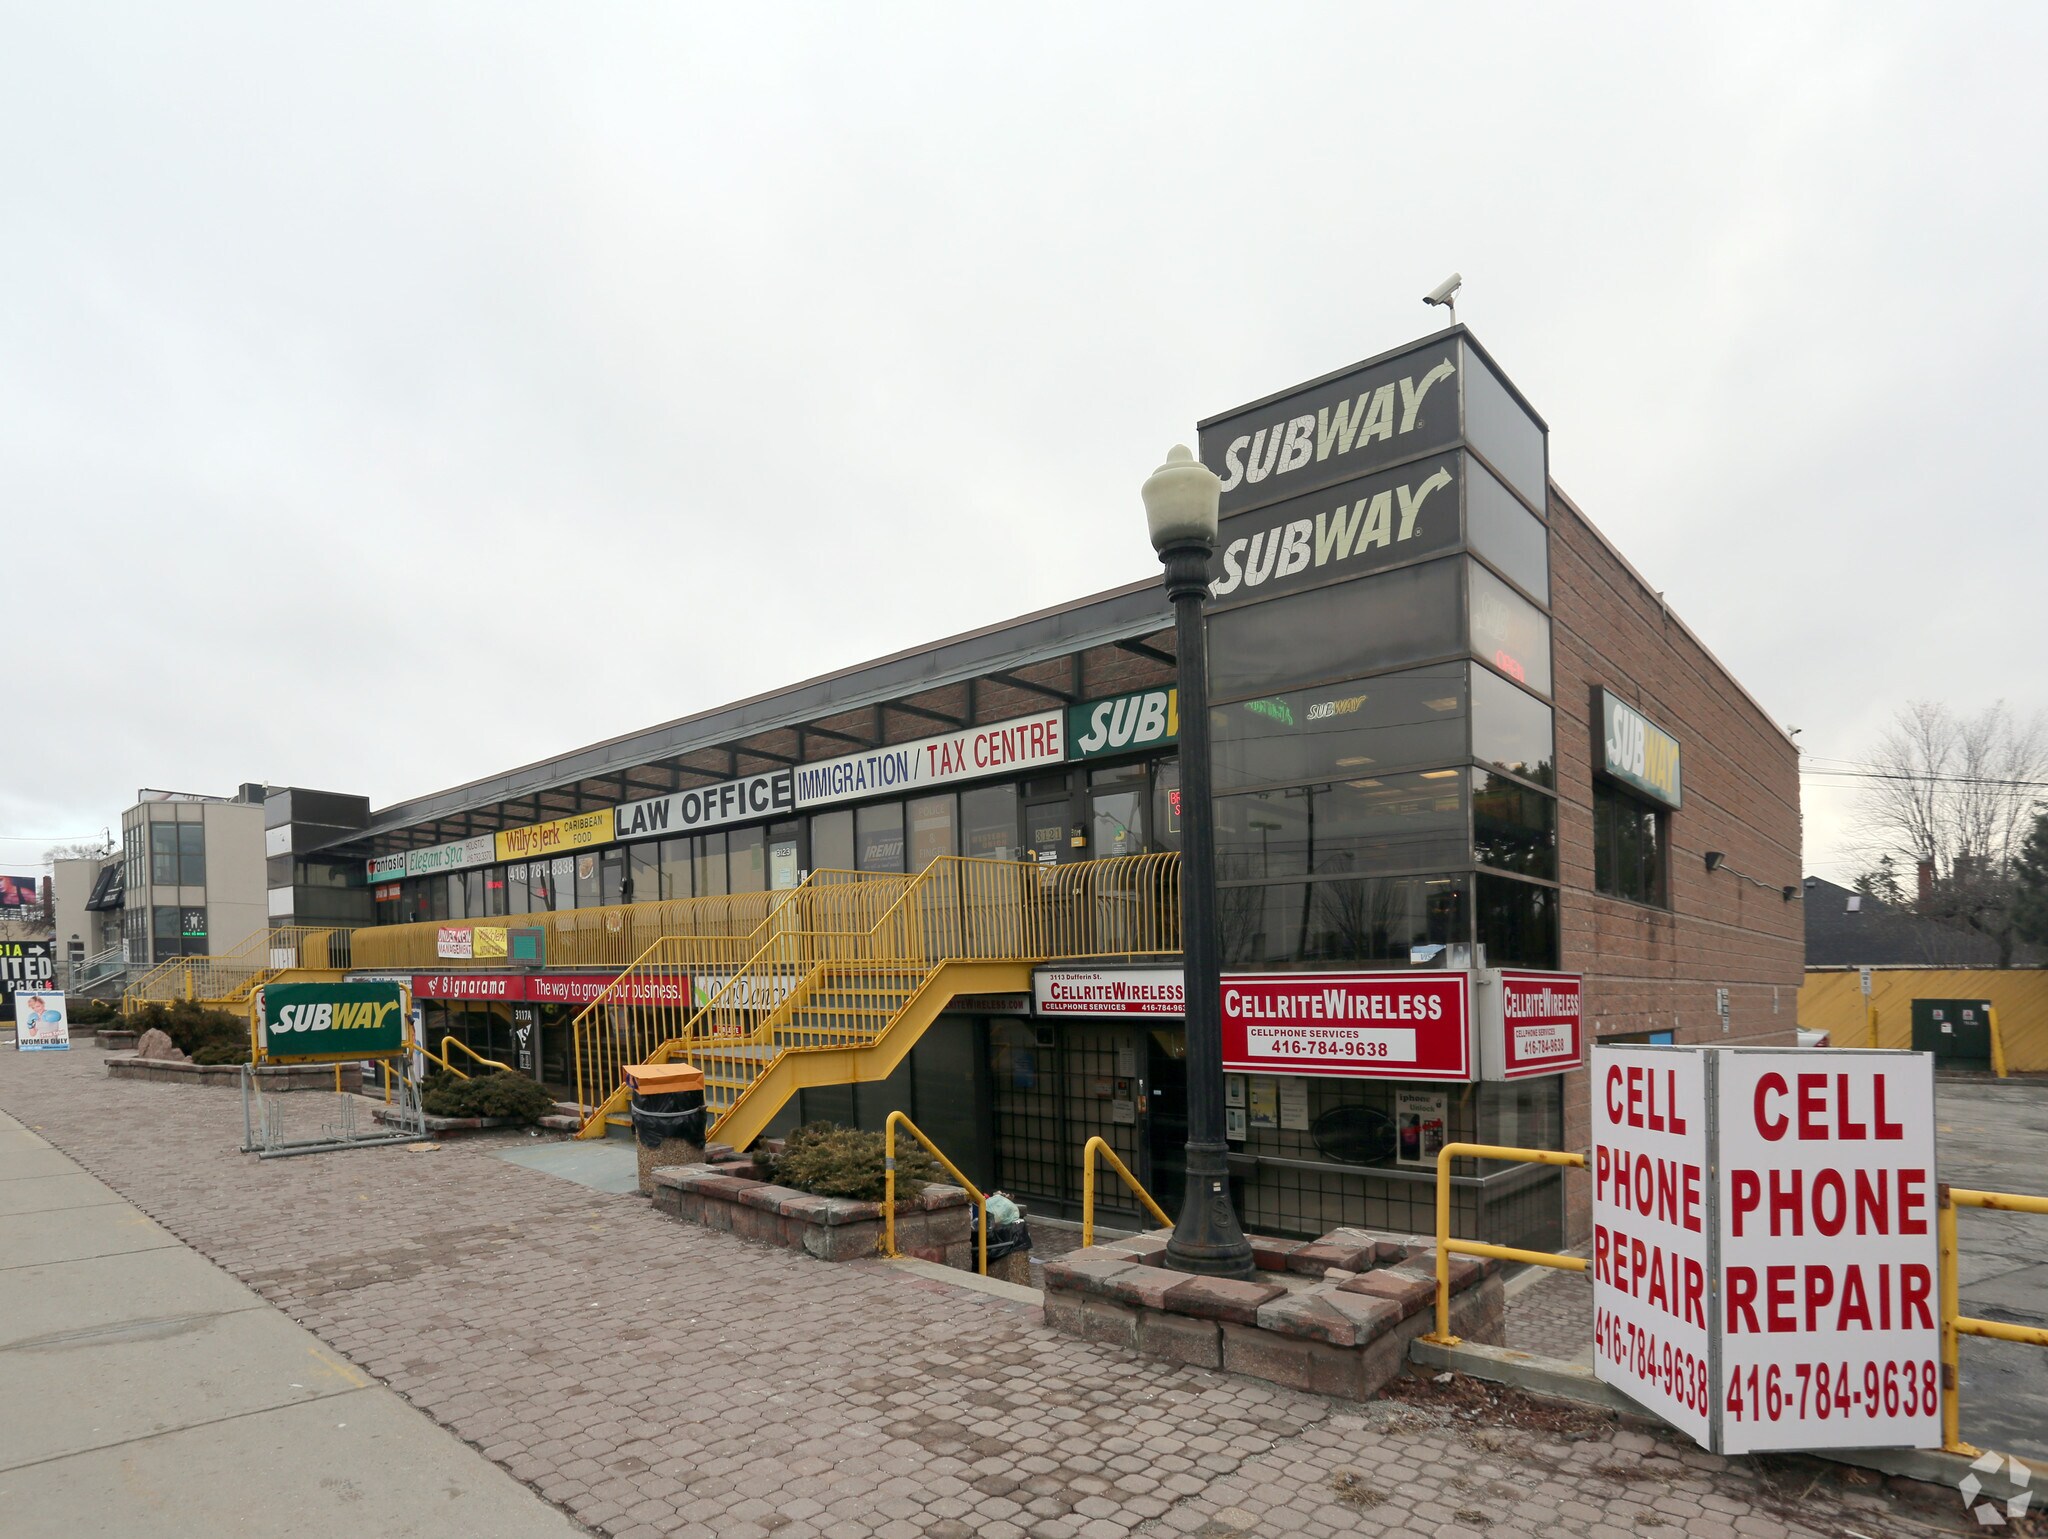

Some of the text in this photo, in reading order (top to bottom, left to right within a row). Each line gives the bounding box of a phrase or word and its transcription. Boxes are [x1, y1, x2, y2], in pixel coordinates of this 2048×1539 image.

[1219, 357, 1456, 493] SUBWAY
[1207, 466, 1453, 600] SUBWAY
[1307, 695, 1368, 720] SUBWAY
[1077, 688, 1179, 756] SUB
[1606, 704, 1679, 794] SUBWAY
[798, 750, 909, 802] IMMIGRATION
[927, 738, 966, 778] TAX
[973, 719, 1059, 769] CENTRE
[616, 773, 792, 836] LAW OFFICE
[564, 815, 603, 832] CARIBBEAN
[1036, 827, 1060, 842] 3121
[506, 822, 560, 855] Willy's Jerk
[573, 831, 592, 844] FOOD
[410, 846, 463, 872] Elegant Spa
[776, 848, 791, 858] 3123
[508, 864, 528, 881] (416)
[552, 860, 574, 875] 8338
[438, 929, 472, 942] UNDER NEW
[438, 944, 472, 955] MANAGEMENT
[442, 977, 505, 997] Signarama
[1066, 973, 1092, 981] Dufferin
[534, 979, 550, 996] The
[552, 984, 569, 1000] way
[571, 981, 581, 997] to
[582, 984, 605, 1001] grow
[269, 999, 399, 1035] SUBWAY
[515, 1010, 532, 1020] 3117A
[1045, 1003, 1088, 1011] CELLPHONE
[1089, 1003, 1126, 1011] SERVICES
[51, 1037, 68, 1045] ONLY
[1250, 1029, 1359, 1039] CELLPHONE SERVICES
[1515, 1027, 1556, 1038] CELLPHONE SERVICES
[1271, 1039, 1388, 1057] 416-784-9638
[1524, 1038, 1565, 1055] 416-784-9638
[1400, 1093, 1431, 1102] iphone
[1410, 1103, 1435, 1112] Unlock
[1606, 1064, 1686, 1135] CELL
[1753, 1072, 1904, 1141] CELL
[1596, 1144, 1702, 1234] PHONE
[1731, 1168, 1928, 1237] PHONE
[1595, 1224, 1706, 1330] REPAIR
[1725, 1264, 1935, 1334] REPAIR
[1595, 1306, 1709, 1418] 416-784-9638
[1725, 1359, 1938, 1422] 416-784-9638
